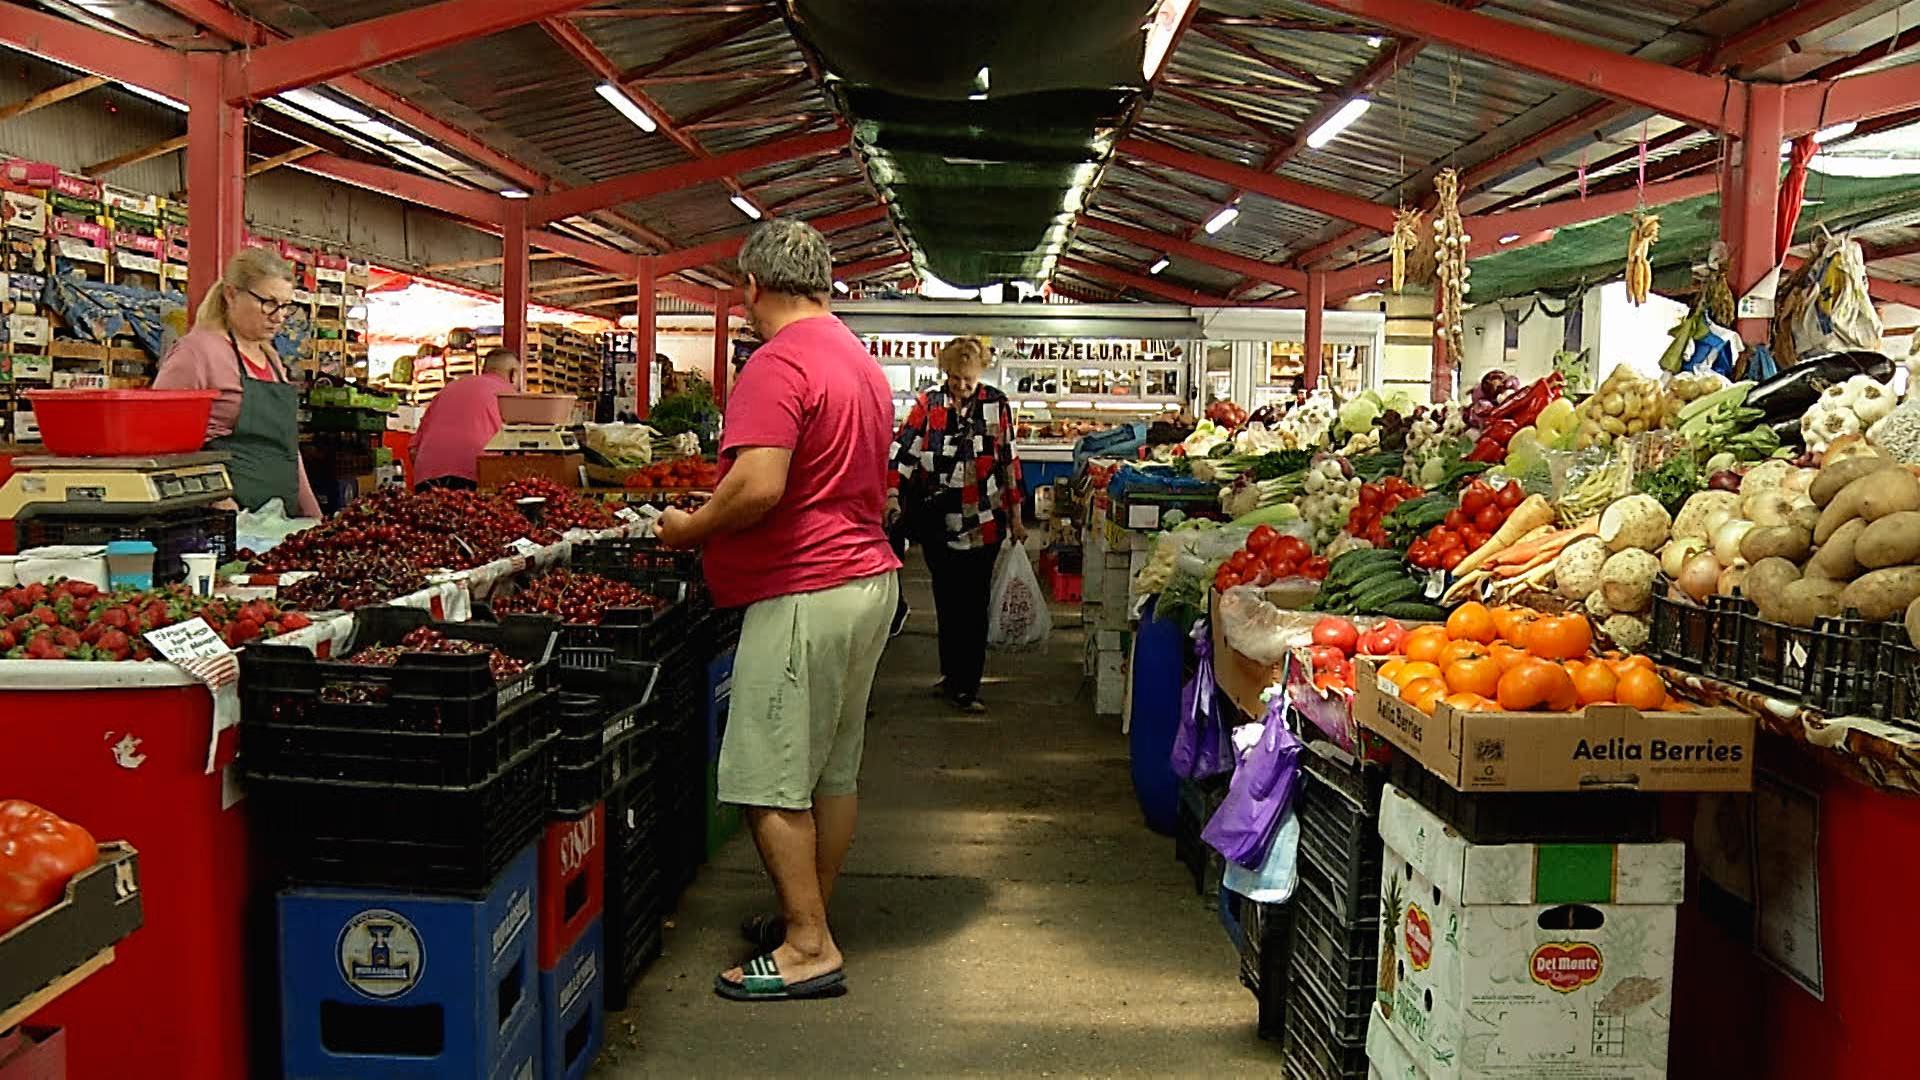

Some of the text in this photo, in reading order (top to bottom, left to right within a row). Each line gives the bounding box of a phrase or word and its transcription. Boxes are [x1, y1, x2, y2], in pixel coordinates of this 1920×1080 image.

[1573, 738, 1743, 761] Aelia Berries
[1537, 957, 1598, 972] Del Monte
